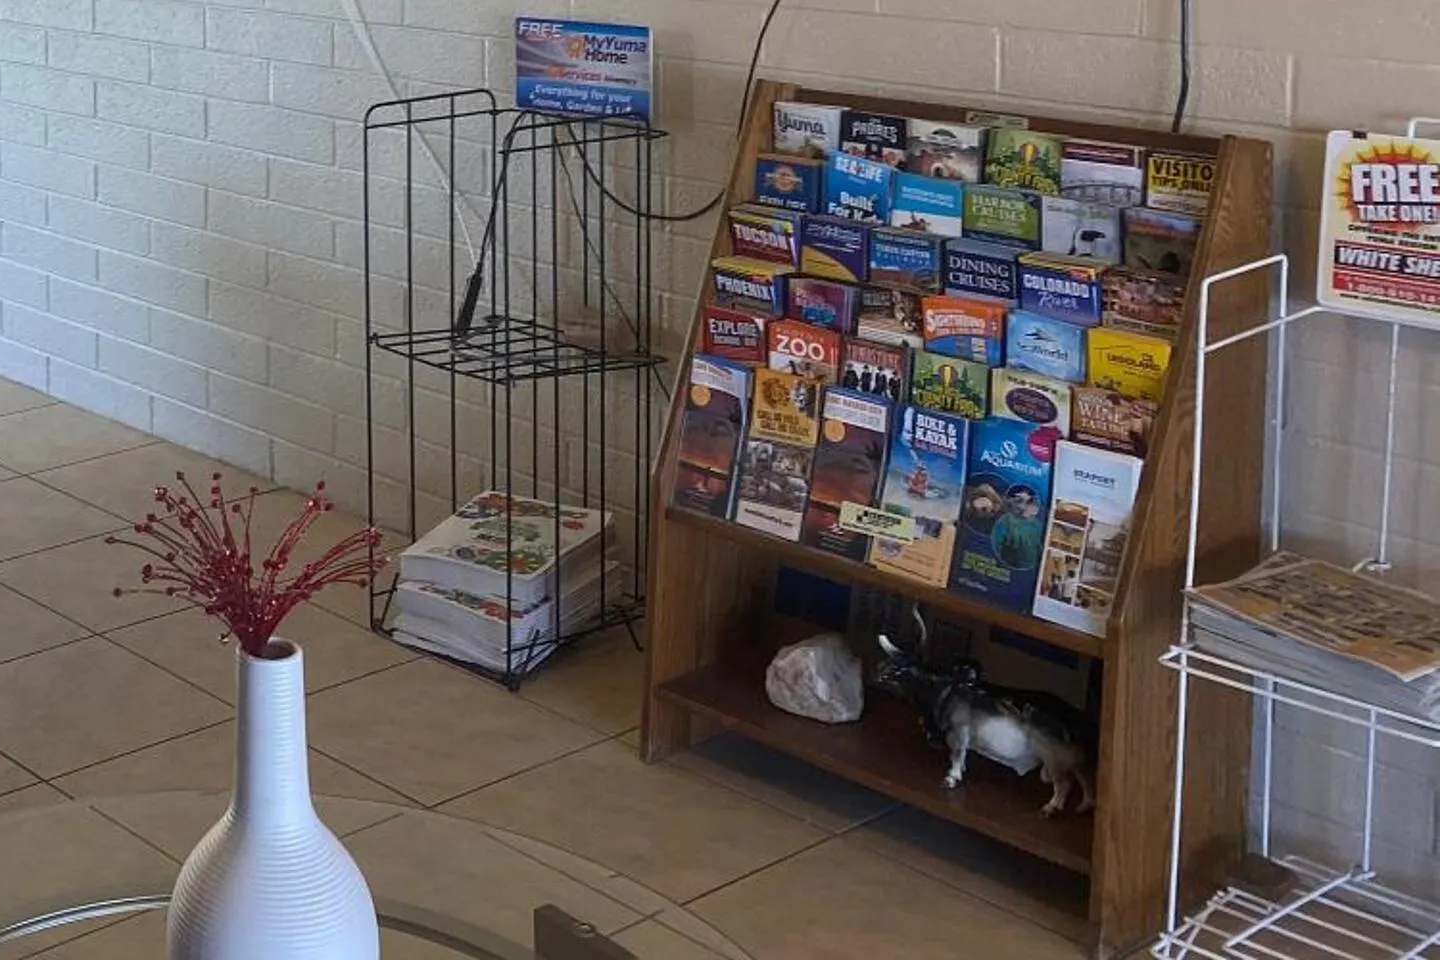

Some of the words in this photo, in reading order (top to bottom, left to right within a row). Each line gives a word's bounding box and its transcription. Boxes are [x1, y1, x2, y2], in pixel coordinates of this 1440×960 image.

[518, 21, 563, 38] FREE
[583, 35, 647, 54] MyYuma
[584, 49, 629, 65] Home
[534, 84, 587, 101] Everything
[775, 109, 826, 136] Yuma
[1153, 158, 1213, 181] VISITO
[1351, 162, 1440, 203] FREE
[1357, 204, 1396, 222] TAKE
[733, 223, 788, 250] TUCSON
[949, 255, 1009, 278] DINING
[1338, 246, 1401, 272] WHITE
[1404, 253, 1440, 277] SHE
[715, 274, 771, 301] PHOENIX
[949, 272, 1011, 293] CRUISES
[1022, 273, 1090, 299] COLORADO
[1037, 291, 1079, 310] River
[710, 318, 759, 338] EXPLORE
[776, 333, 825, 362] ZOO
[1080, 400, 1126, 425] WINE
[916, 413, 946, 432] BIKE
[948, 422, 957, 437] &
[915, 426, 958, 450] KAYAK
[980, 450, 1043, 477] AQUARIUM
